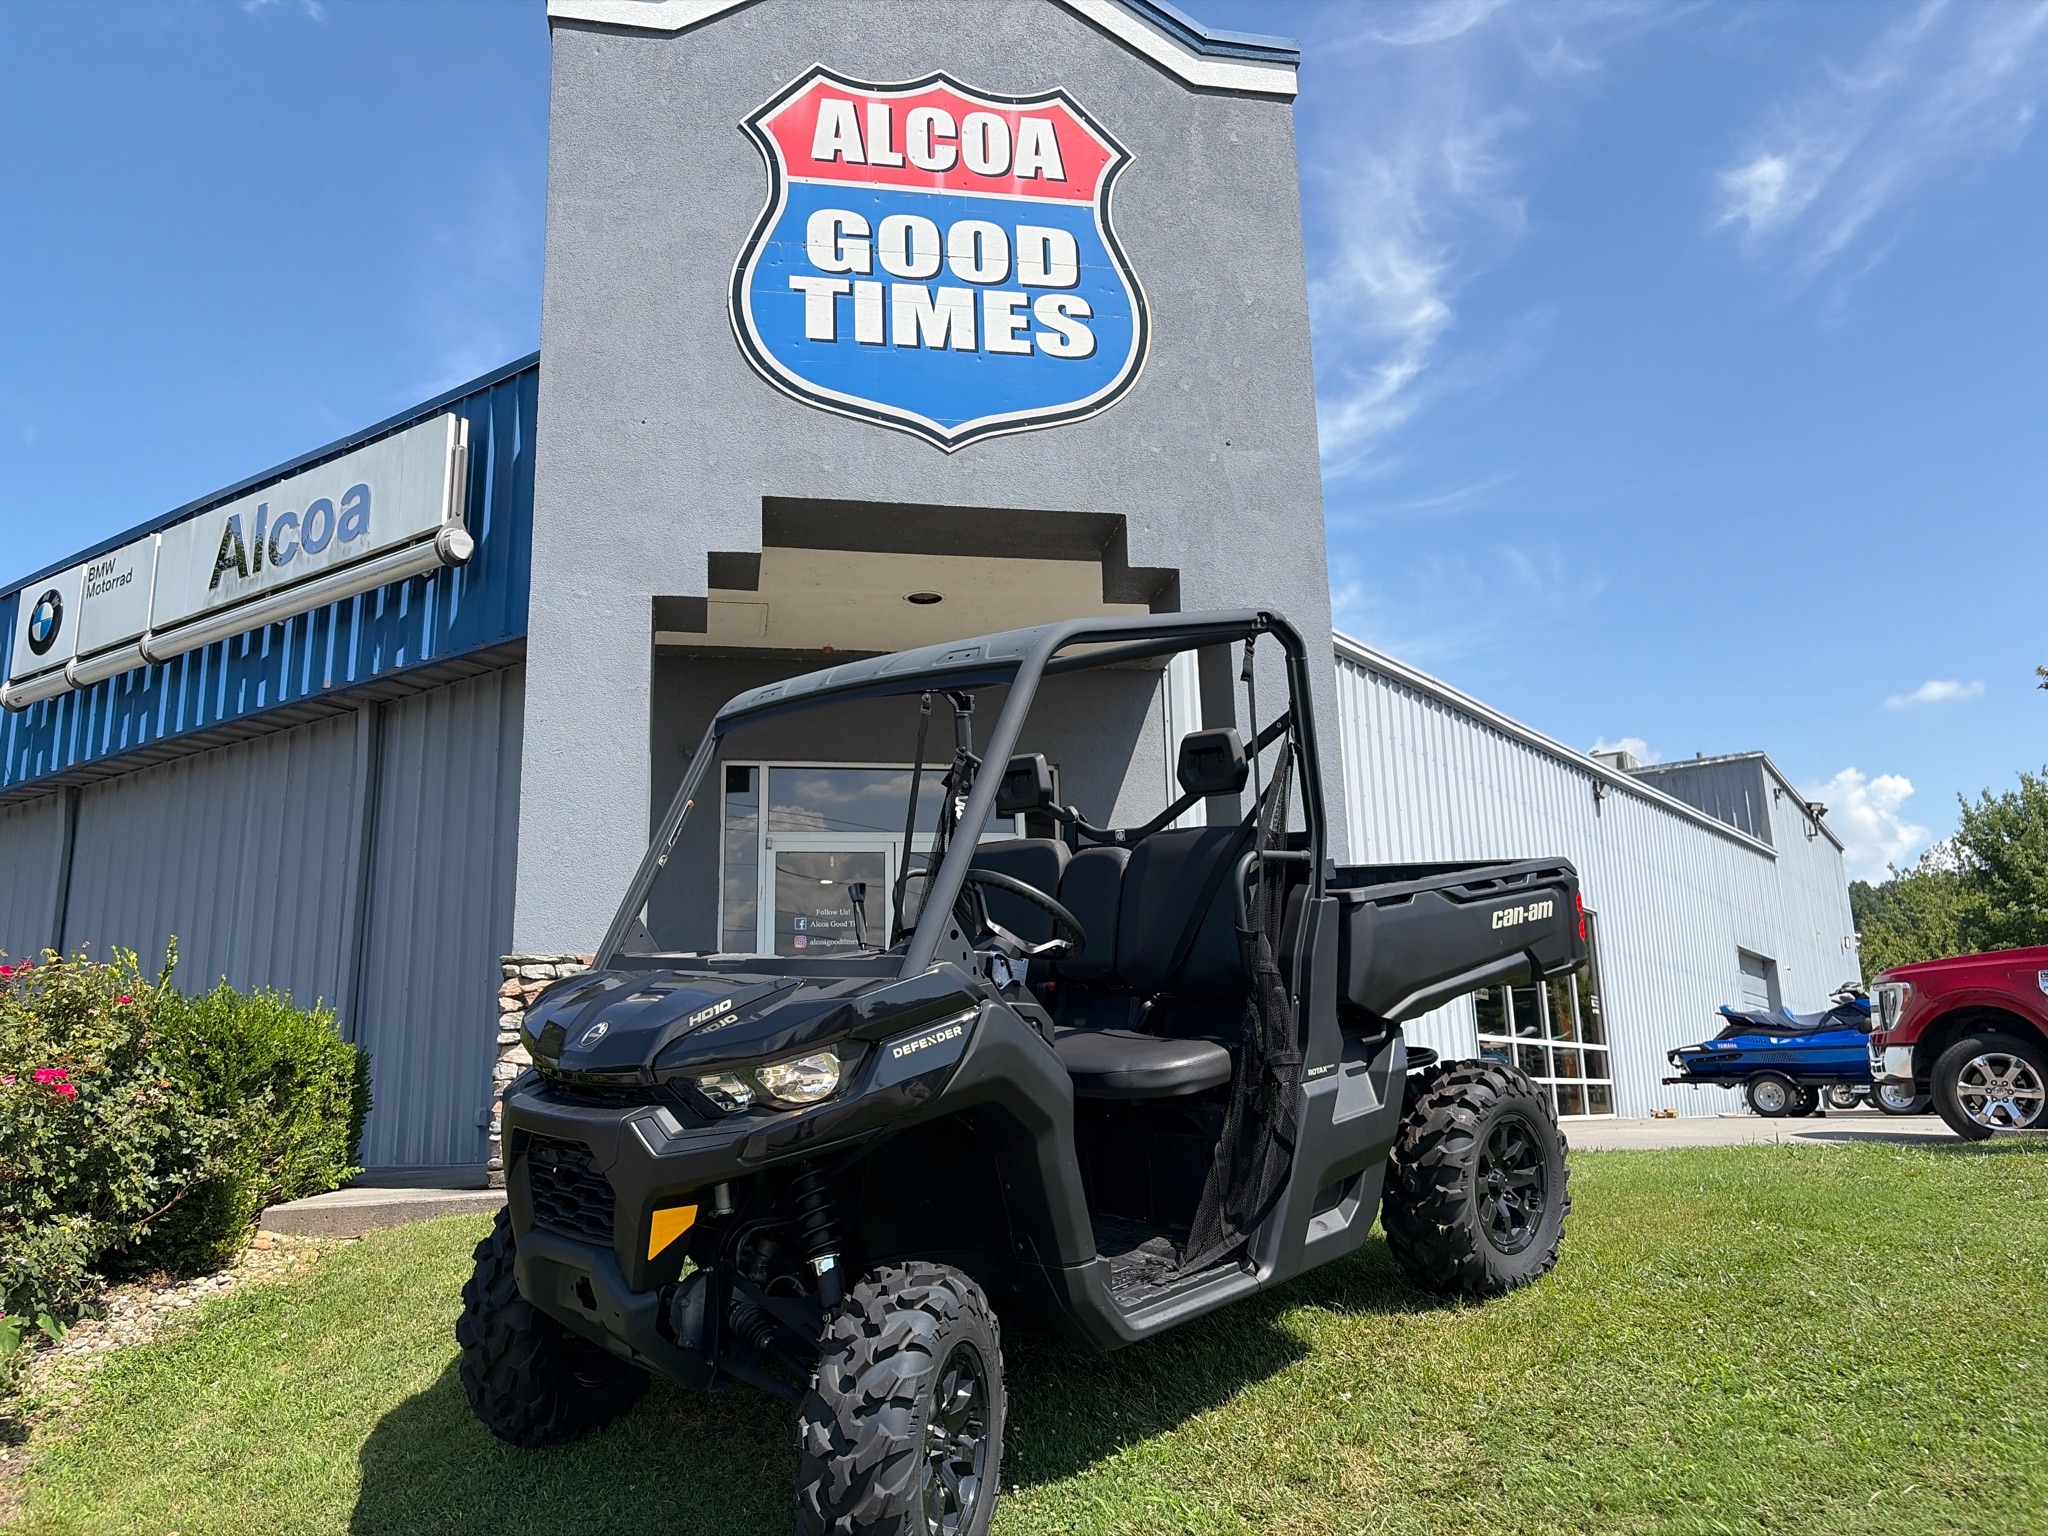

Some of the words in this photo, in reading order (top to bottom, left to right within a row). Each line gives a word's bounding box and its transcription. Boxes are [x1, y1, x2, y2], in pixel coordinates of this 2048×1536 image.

[811, 97, 1066, 181] ALCOA
[806, 208, 1079, 287] GOOD
[788, 275, 1096, 358] TIMES
[208, 483, 371, 590] Alcoa
[86, 567, 133, 600] Motorrad
[88, 557, 116, 582] BMW
[810, 920, 829, 928] Alcoa
[830, 920, 847, 928] Good
[1491, 900, 1553, 929] can-am
[689, 999, 732, 1027] HD10
[892, 1025, 963, 1059] DEFENDER
[1307, 1065, 1328, 1077] ROTAX
